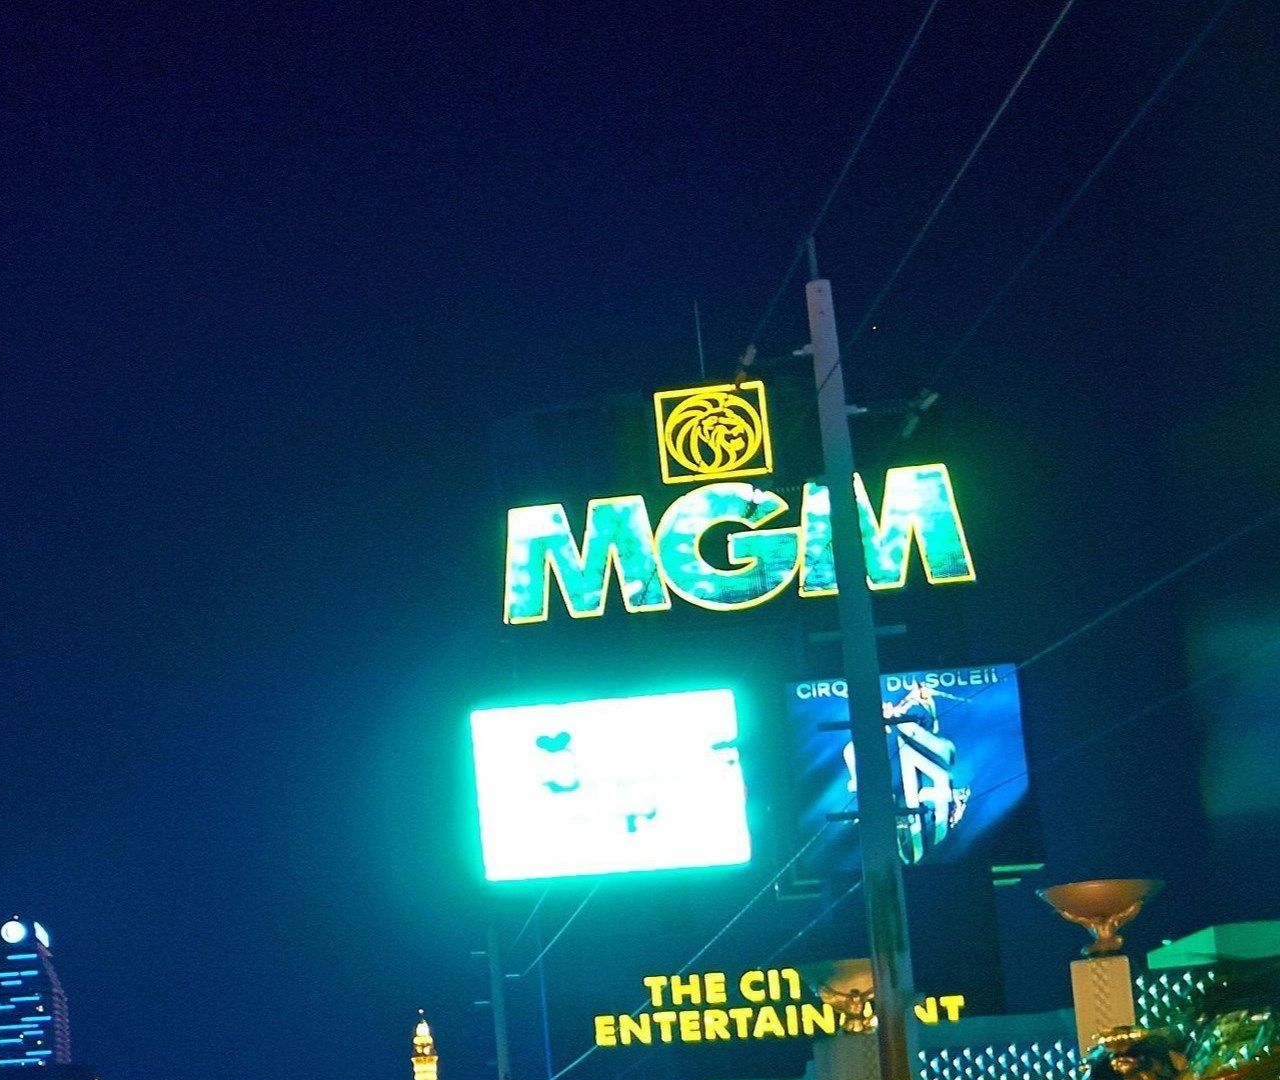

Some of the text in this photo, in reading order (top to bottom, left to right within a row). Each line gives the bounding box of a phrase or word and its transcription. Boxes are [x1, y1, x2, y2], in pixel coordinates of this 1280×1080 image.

[503, 463, 977, 624] MGM
[795, 681, 849, 700] CIRQ
[886, 674, 919, 692] DU
[643, 967, 801, 1007] THE CIT
[594, 994, 965, 1047] ENTERTAINNT
